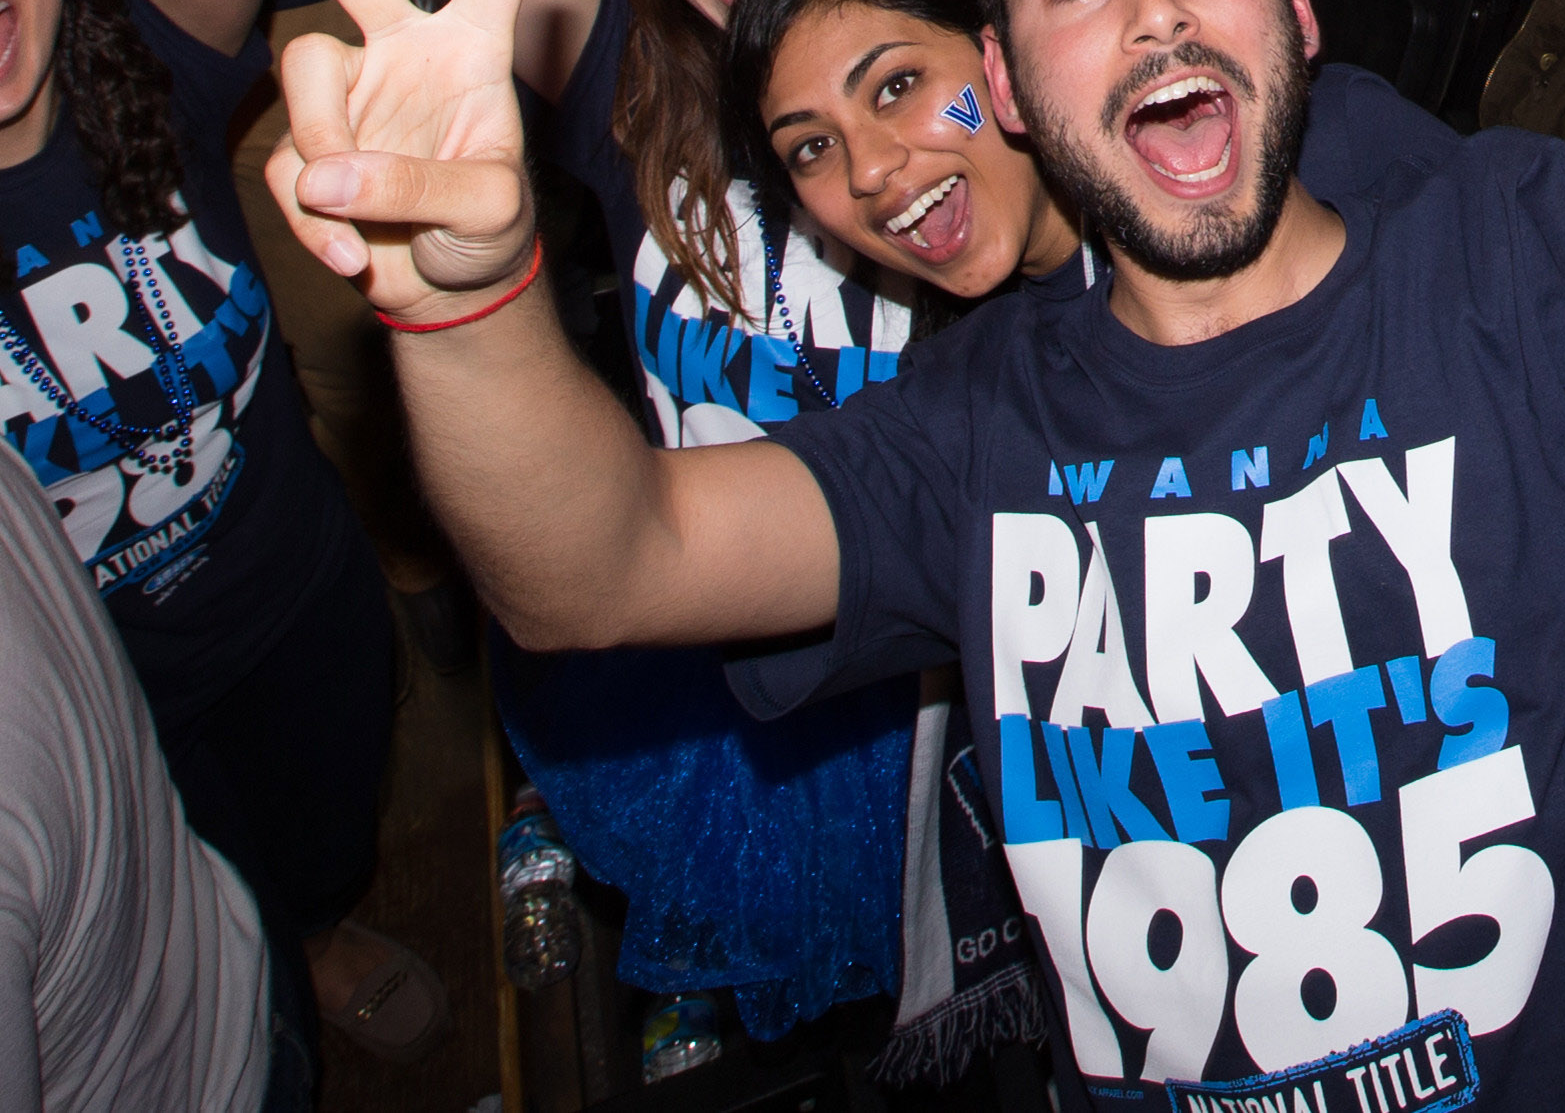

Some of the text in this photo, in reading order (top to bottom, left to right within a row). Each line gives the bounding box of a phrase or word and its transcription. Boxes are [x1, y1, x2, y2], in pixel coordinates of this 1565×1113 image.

[940, 82, 987, 136] V
[94, 510, 201, 589] ATIONAL
[992, 436, 1474, 731] PARTY
[1000, 636, 1511, 850] LIKE IT'S
[957, 928, 997, 964] GO
[1003, 744, 1556, 1084] 1985
